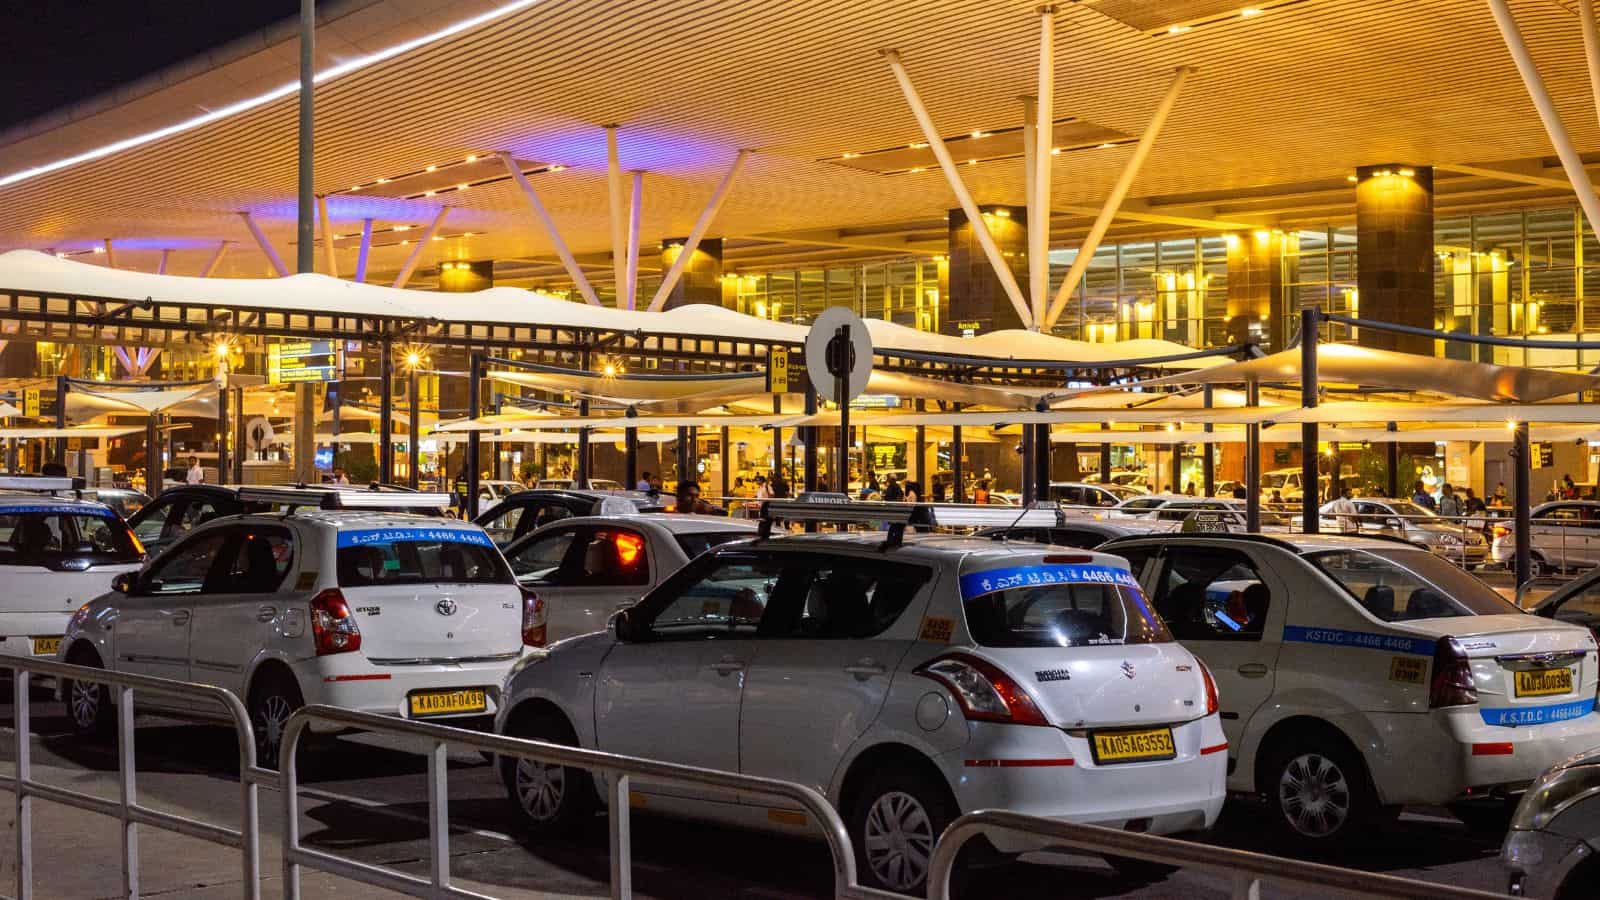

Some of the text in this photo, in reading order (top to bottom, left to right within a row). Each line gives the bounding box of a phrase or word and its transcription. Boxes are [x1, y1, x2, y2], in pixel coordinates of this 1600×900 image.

[774, 356, 785, 369] 19
[808, 495, 848, 504] AIRPORT
[1082, 570, 1114, 582] 4466
[1305, 630, 1344, 642] KSTDC
[419, 691, 484, 711] KA03AF0499
[1101, 734, 1172, 755] KA05AG3552
